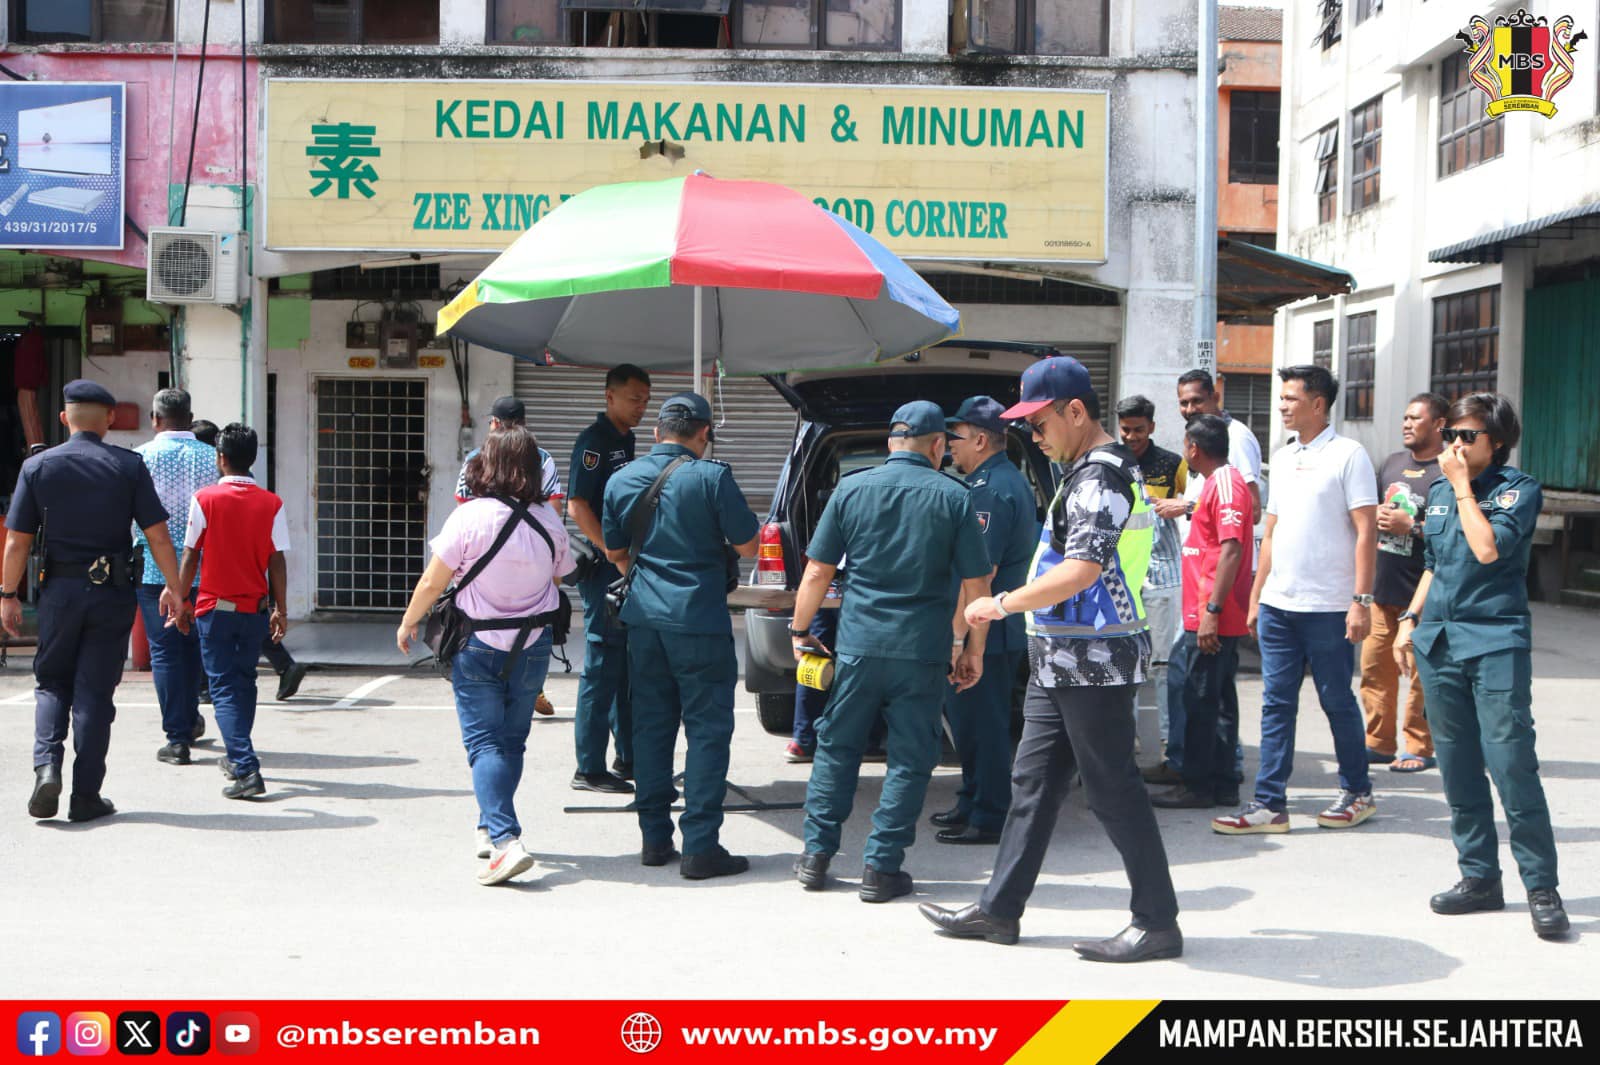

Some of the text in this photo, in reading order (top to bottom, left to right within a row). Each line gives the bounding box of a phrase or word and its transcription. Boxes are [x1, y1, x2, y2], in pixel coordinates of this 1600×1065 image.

[435, 99, 1084, 148] KEDAI MAKANAN & MINUMAN
[305, 121, 381, 199] 素
[4, 221, 97, 234] 439/31/2017/5
[412, 192, 1008, 239] ZEE XING OD CORNER
